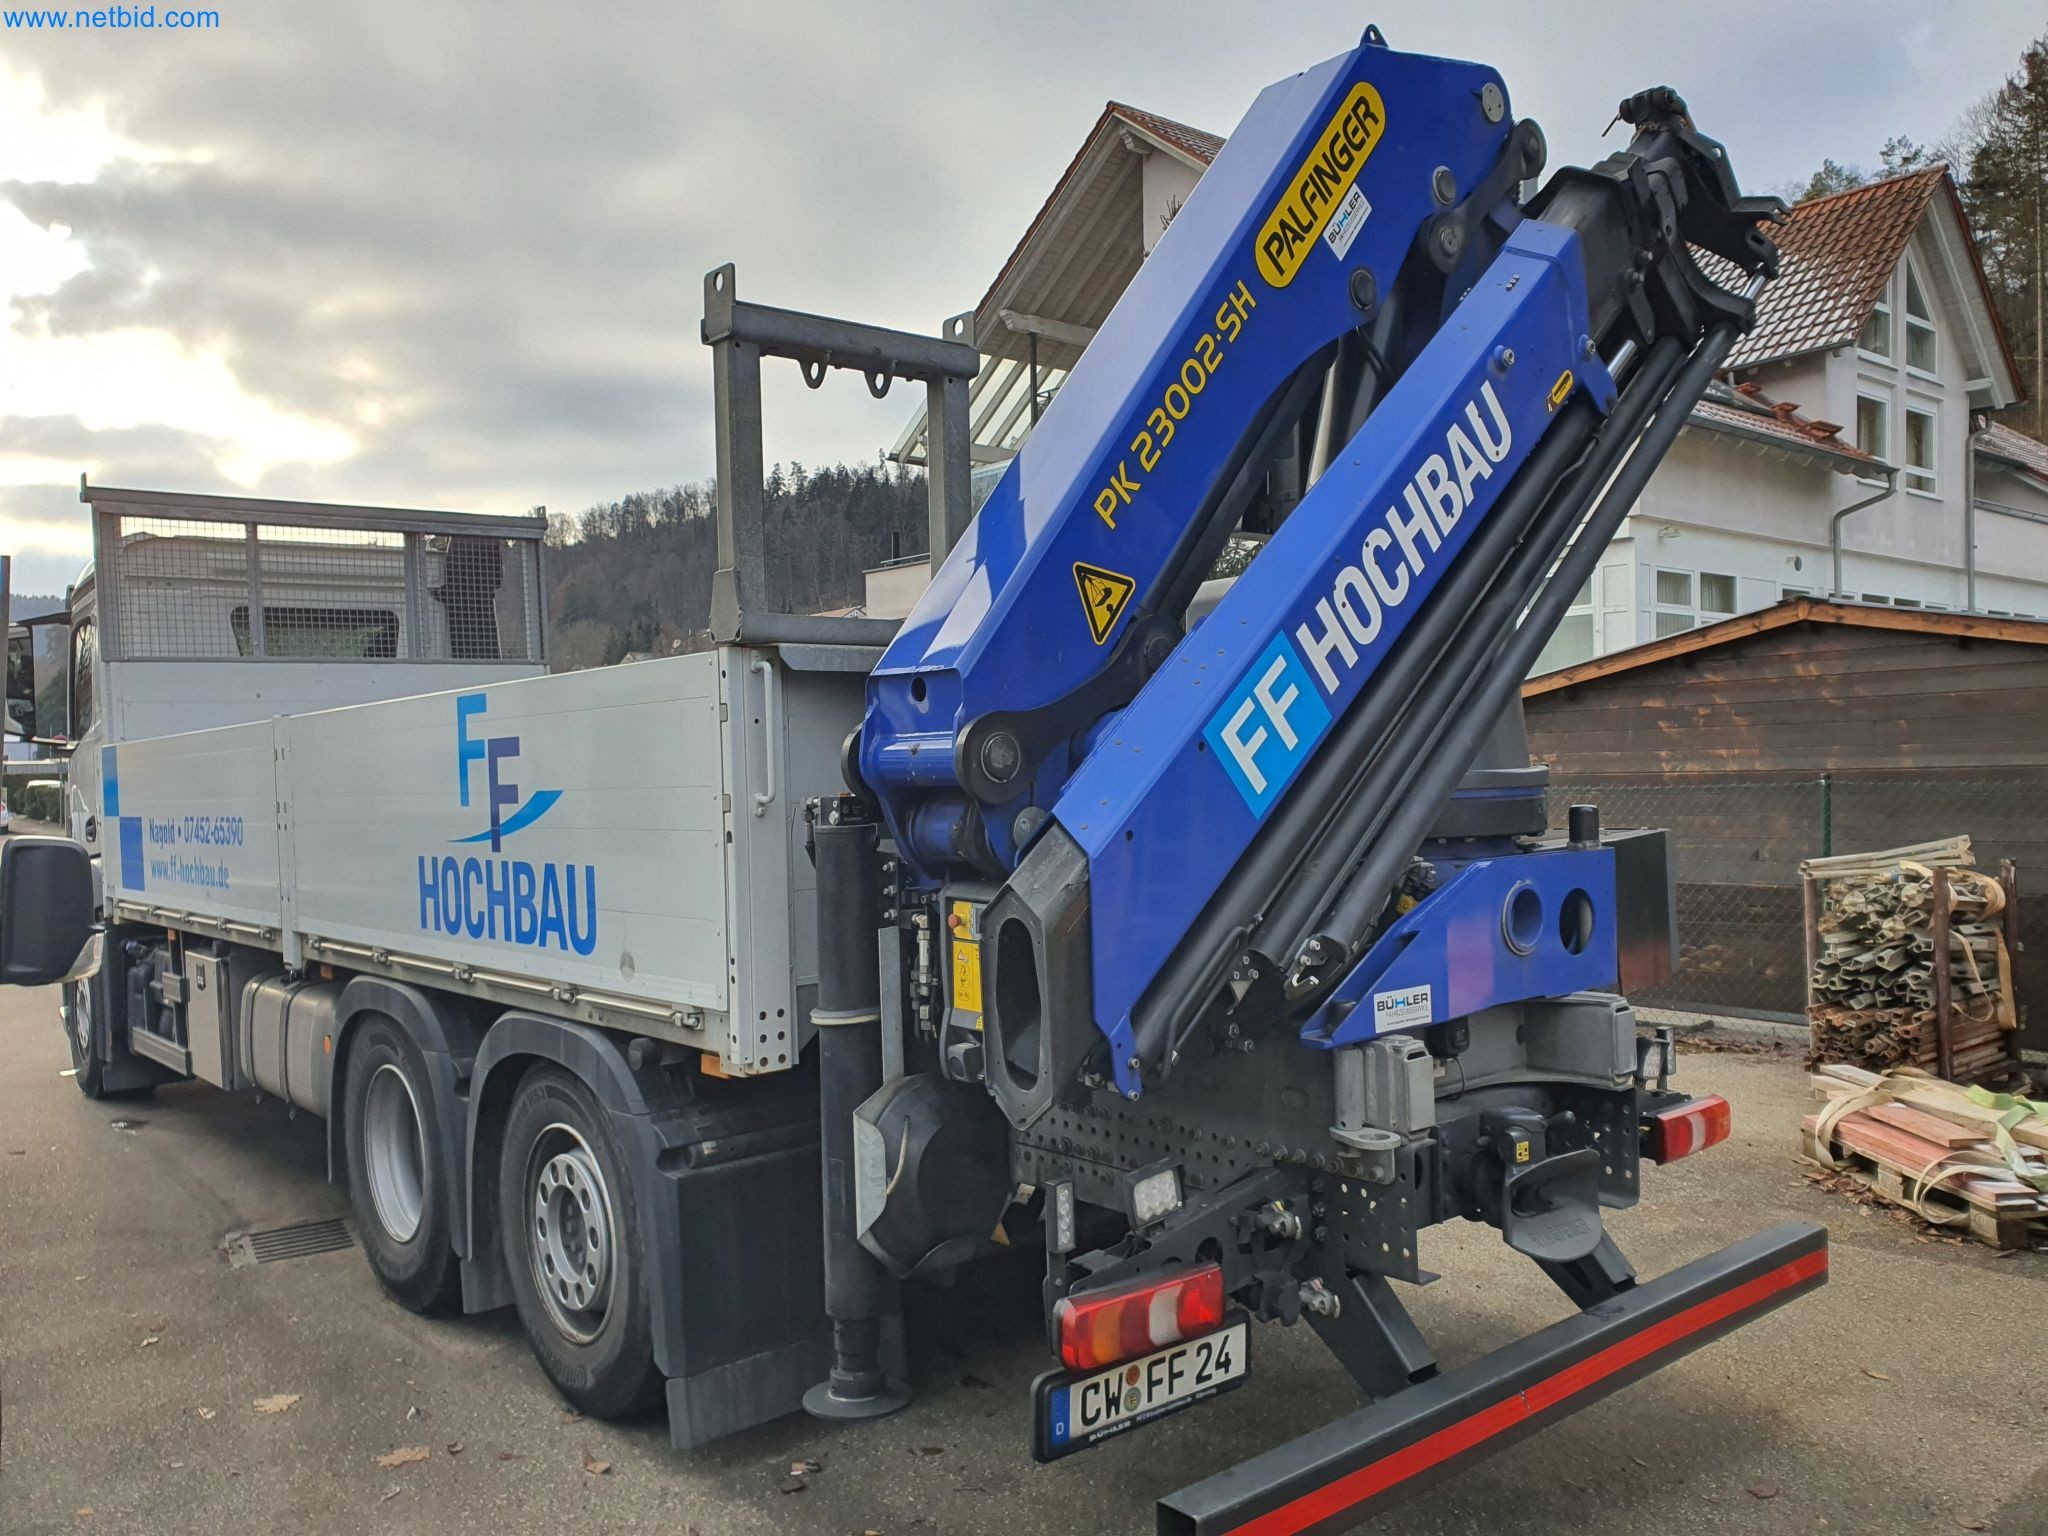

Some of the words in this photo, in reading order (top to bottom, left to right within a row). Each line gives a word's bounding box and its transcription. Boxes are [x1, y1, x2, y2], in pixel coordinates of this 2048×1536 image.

[1262, 82, 1380, 276] PALFINGER
[1328, 191, 1361, 244] BÜHLER
[1093, 460, 1142, 530] PK
[1220, 654, 1299, 795] FF
[1296, 380, 1512, 695] HOCHBAU
[149, 817, 175, 850] Nagold
[184, 816, 244, 846] 07452-65390
[151, 855, 229, 888] www.ff-hochbau.de
[418, 855, 597, 956] HOCHBAU
[1377, 992, 1428, 1012] BÜHLER
[1081, 1372, 1123, 1427] CW
[1147, 1349, 1187, 1403] FF
[1195, 1334, 1232, 1385] 24
[1055, 1422, 1064, 1436] D
